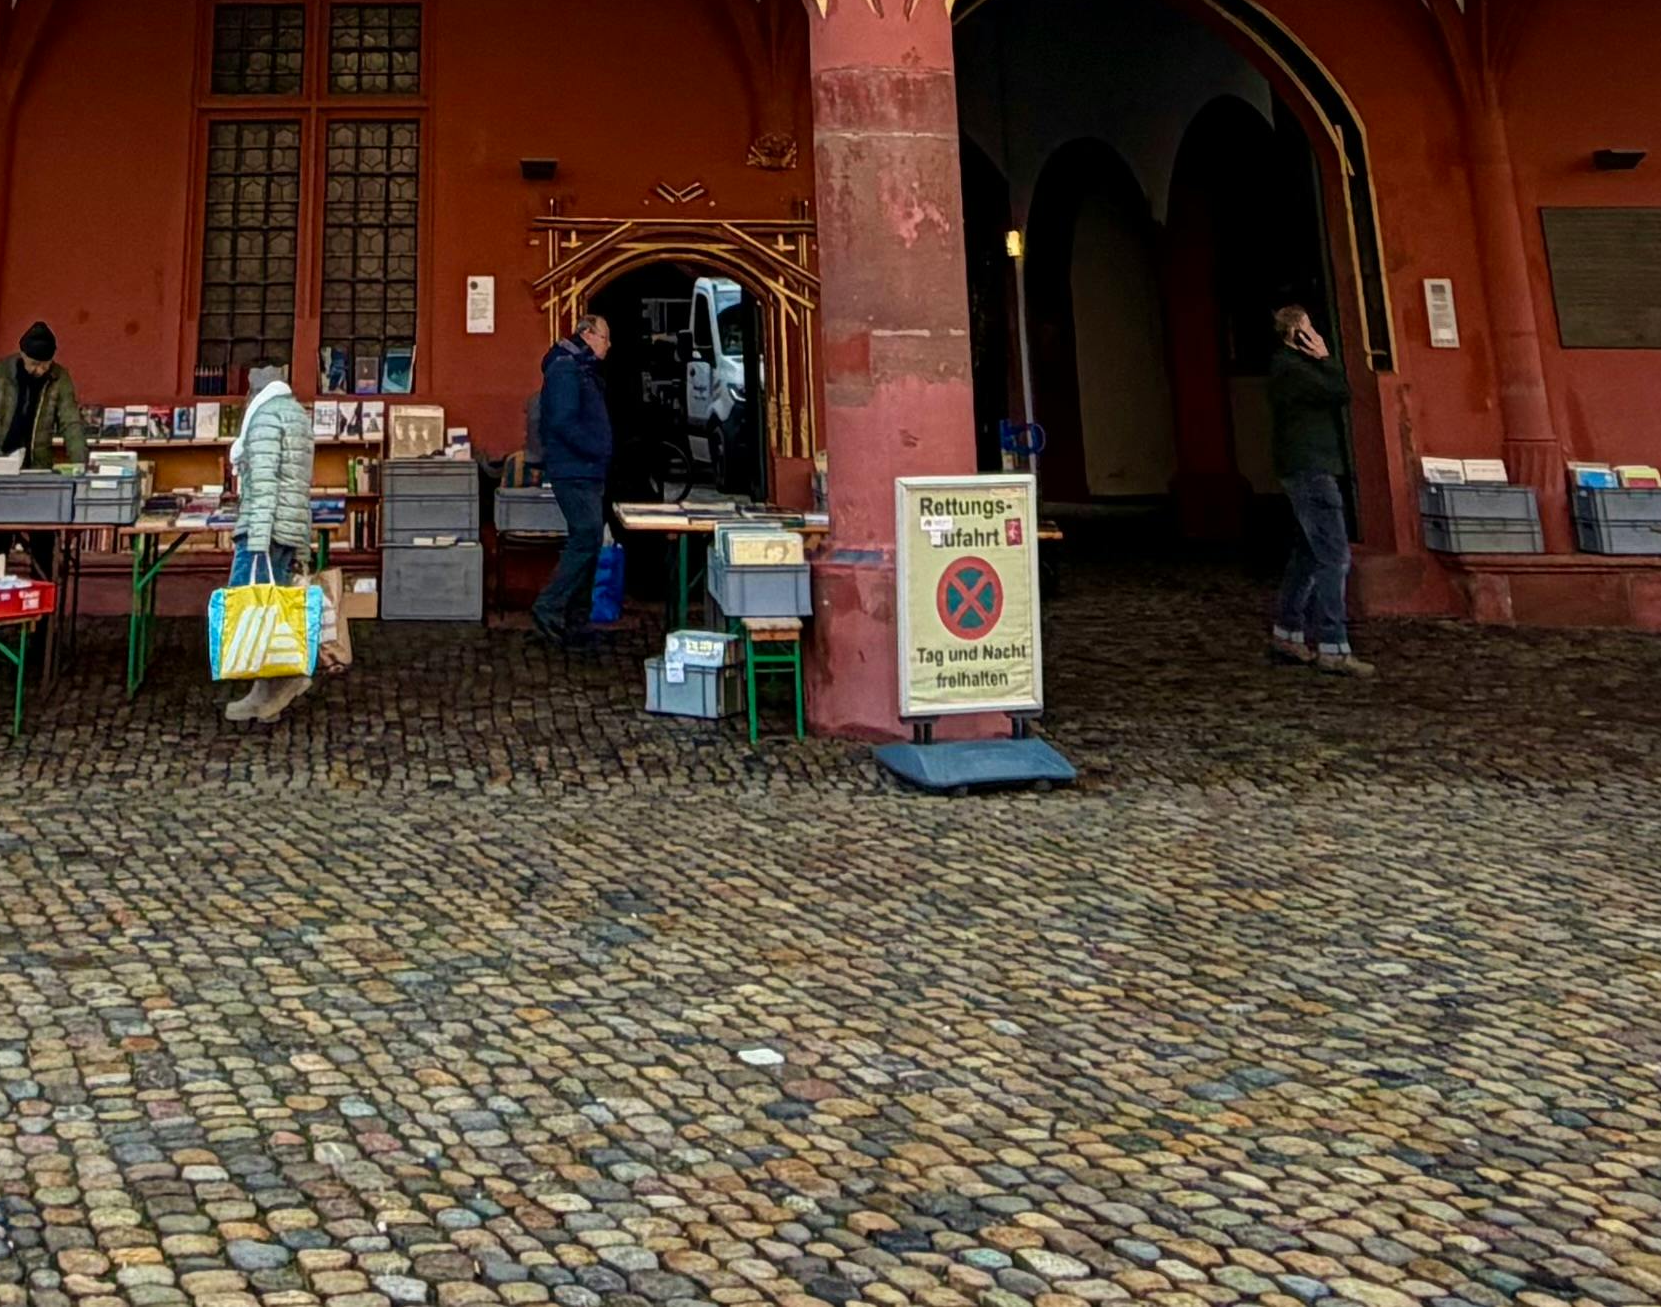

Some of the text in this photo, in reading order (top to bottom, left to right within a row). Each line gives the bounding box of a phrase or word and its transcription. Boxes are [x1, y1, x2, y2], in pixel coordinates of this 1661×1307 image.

[920, 497, 1012, 519] Rettungs-
[932, 528, 1000, 548] ufahrt
[916, 644, 1027, 667] Tag und Nacht
[936, 671, 1009, 688] freihalten
